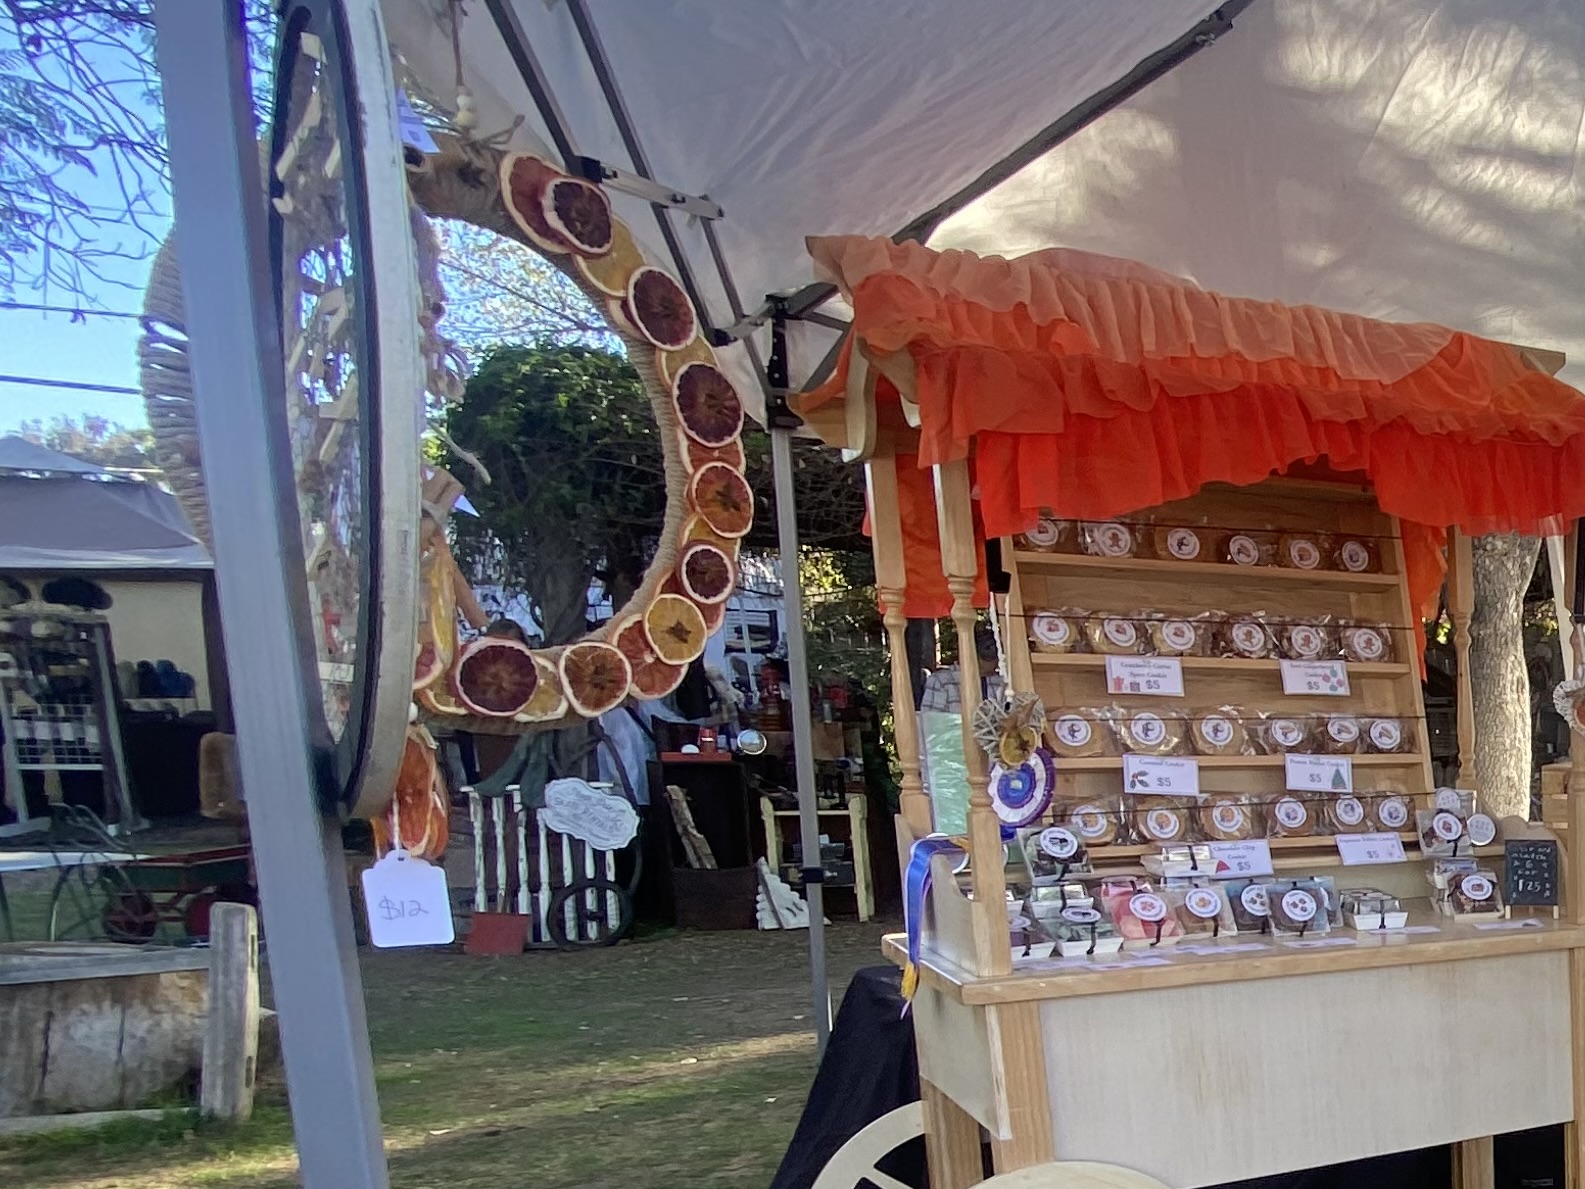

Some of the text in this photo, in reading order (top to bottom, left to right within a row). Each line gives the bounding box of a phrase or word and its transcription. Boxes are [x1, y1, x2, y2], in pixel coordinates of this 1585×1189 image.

[1145, 679, 1161, 690] $5
[1306, 681, 1320, 691] $5
[1157, 777, 1171, 787] $5
[1309, 773, 1322, 783] $5
[1366, 850, 1379, 859] $5
[1237, 861, 1251, 871] $5
[378, 894, 430, 921] $12
